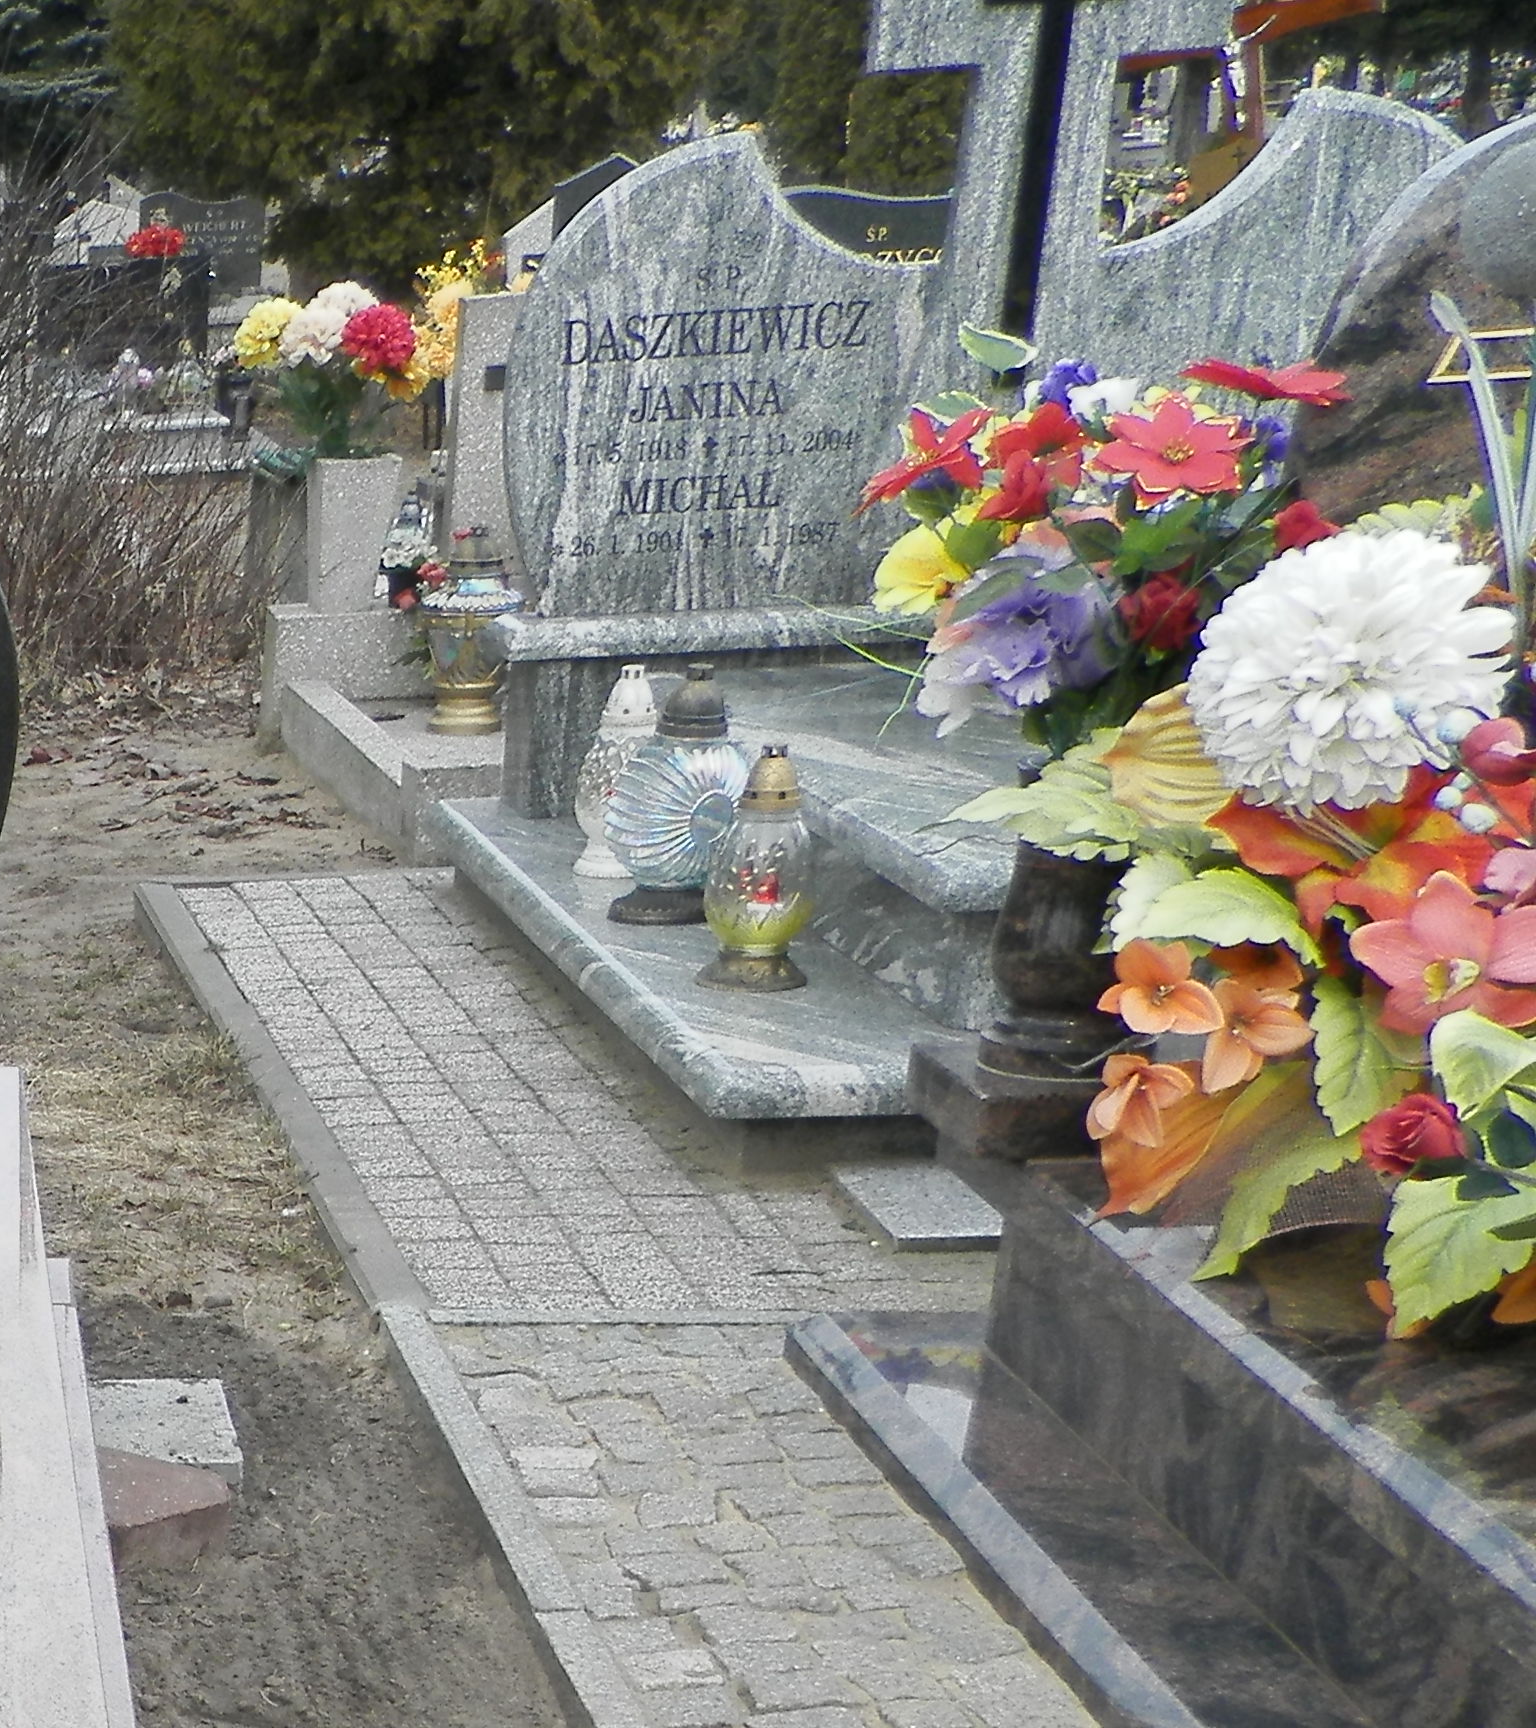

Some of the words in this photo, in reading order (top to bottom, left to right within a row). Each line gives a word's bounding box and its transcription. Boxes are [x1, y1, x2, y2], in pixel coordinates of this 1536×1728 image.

[562, 301, 872, 366] DASZKIEWICZ
[629, 379, 785, 423] JANINA
[616, 468, 781, 517] MICHAŁ
